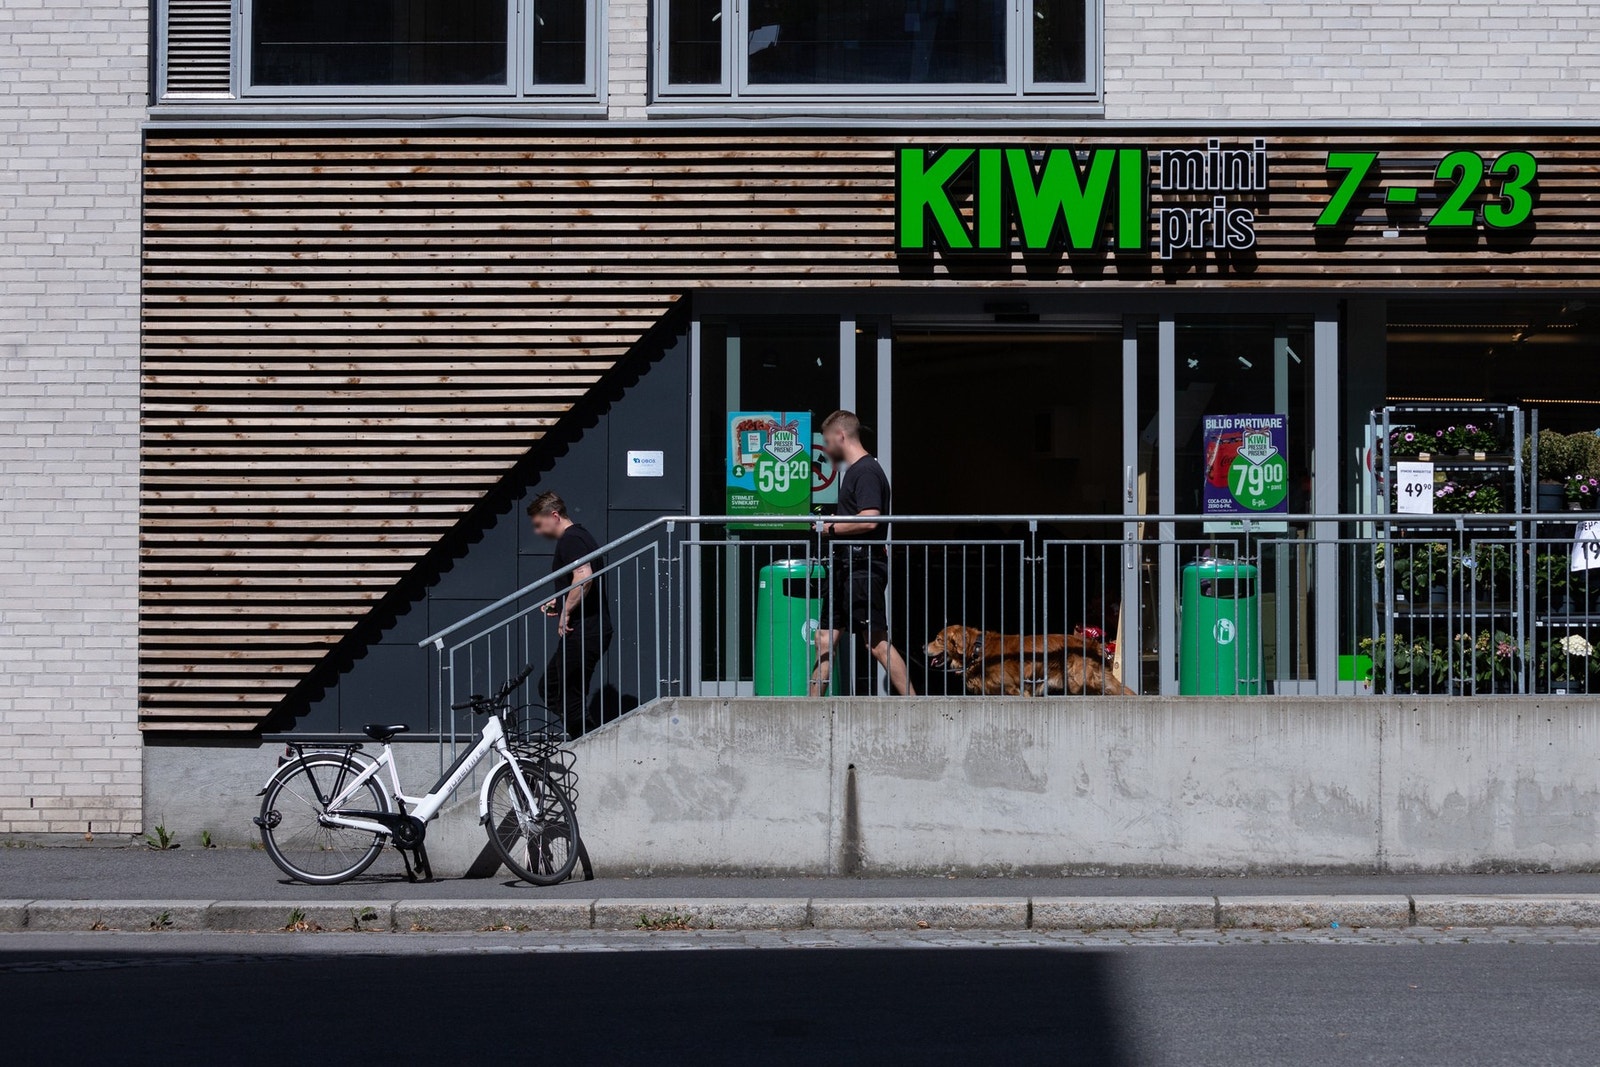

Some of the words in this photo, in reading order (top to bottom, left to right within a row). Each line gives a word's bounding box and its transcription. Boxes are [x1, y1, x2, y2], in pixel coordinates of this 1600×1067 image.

[901, 149, 1141, 248] KIWI
[1160, 138, 1266, 190] mini
[1160, 196, 1256, 259] pris
[1205, 418, 1232, 429] BILLIG
[1234, 418, 1282, 429] PARTIVARE
[774, 432, 793, 440] KIWI
[1247, 435, 1267, 444] KIWI
